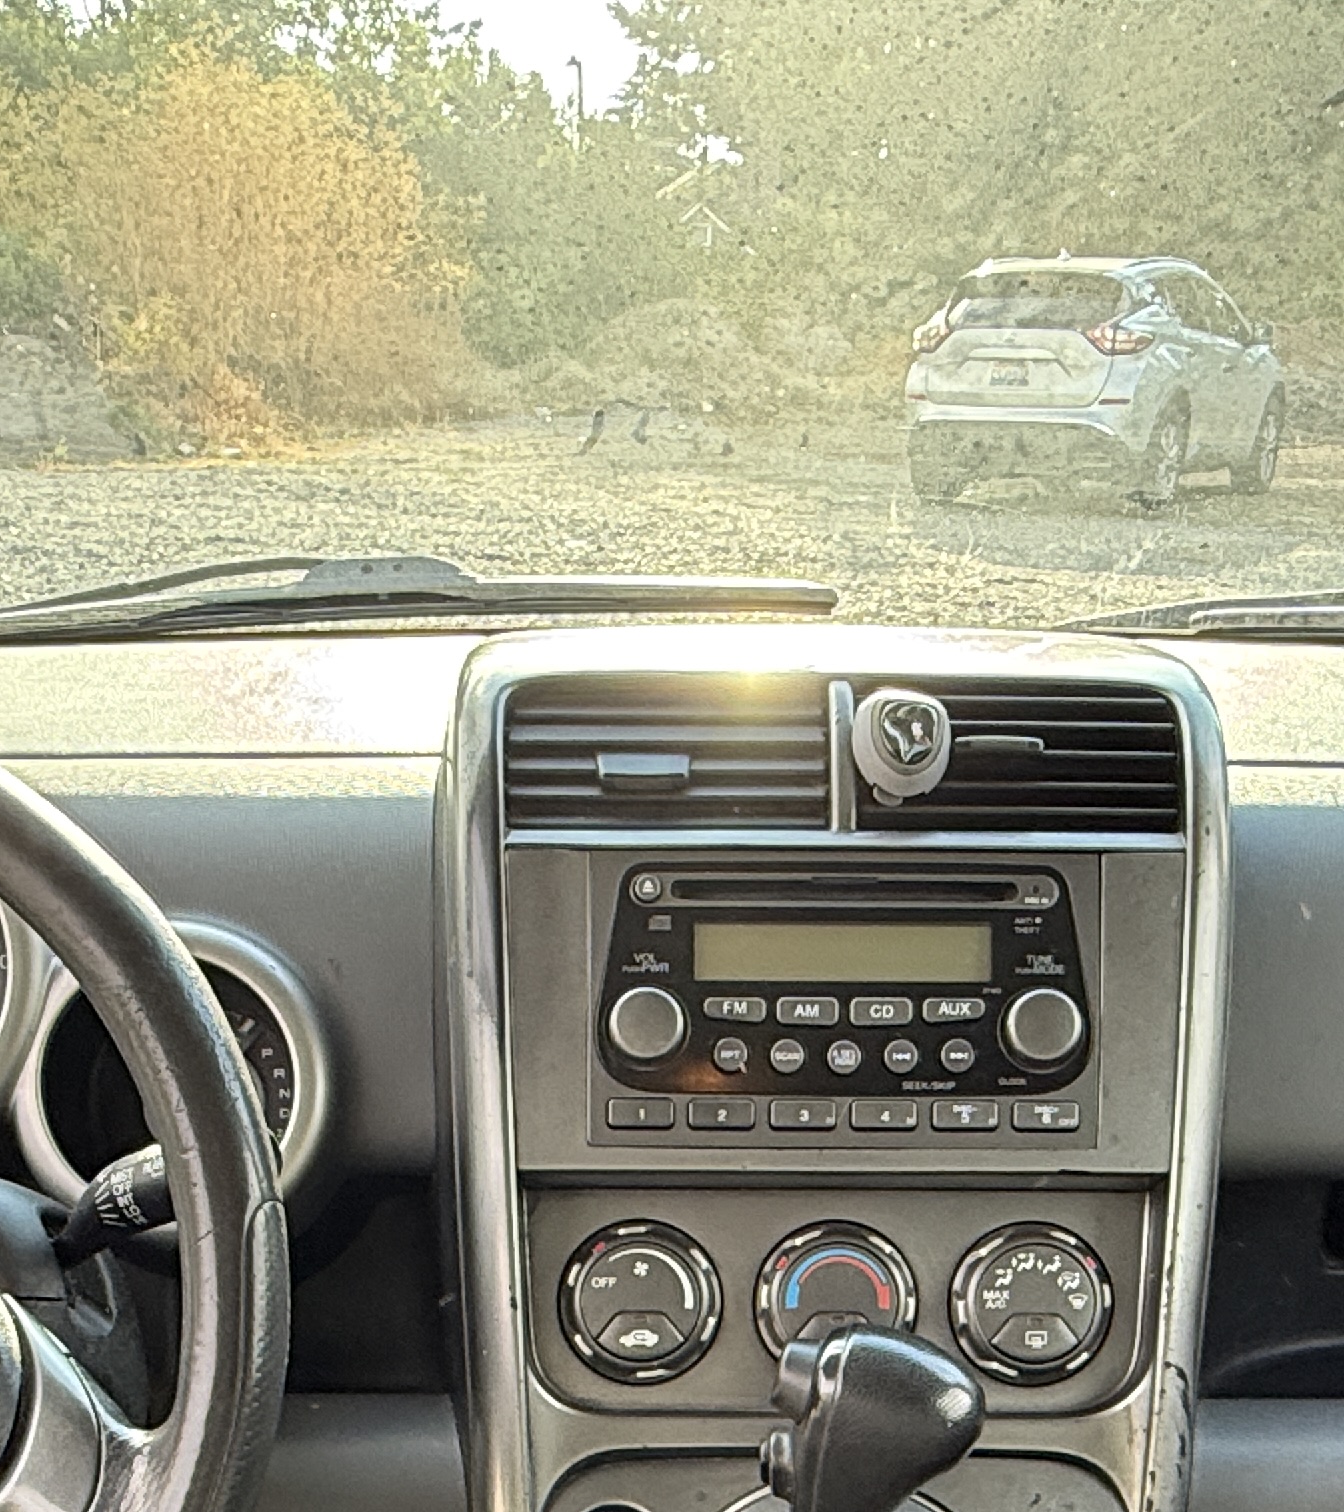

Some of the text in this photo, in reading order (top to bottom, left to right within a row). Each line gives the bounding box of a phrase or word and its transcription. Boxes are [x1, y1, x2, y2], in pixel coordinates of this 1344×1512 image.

[722, 1001, 748, 1015] FM
[794, 1004, 820, 1018] AM
[869, 1004, 894, 1018] CD
[938, 1002, 972, 1016] AUX
[261, 1047, 274, 1059] P
[273, 1068, 286, 1079] R
[279, 1088, 291, 1099] N
[279, 1108, 291, 1119] D
[638, 1108, 646, 1121] 1
[717, 1109, 727, 1122] 2
[799, 1109, 809, 1122] 3
[880, 1110, 890, 1122] 4
[590, 1276, 617, 1288] OFF
[983, 1290, 1010, 1300] MAX
